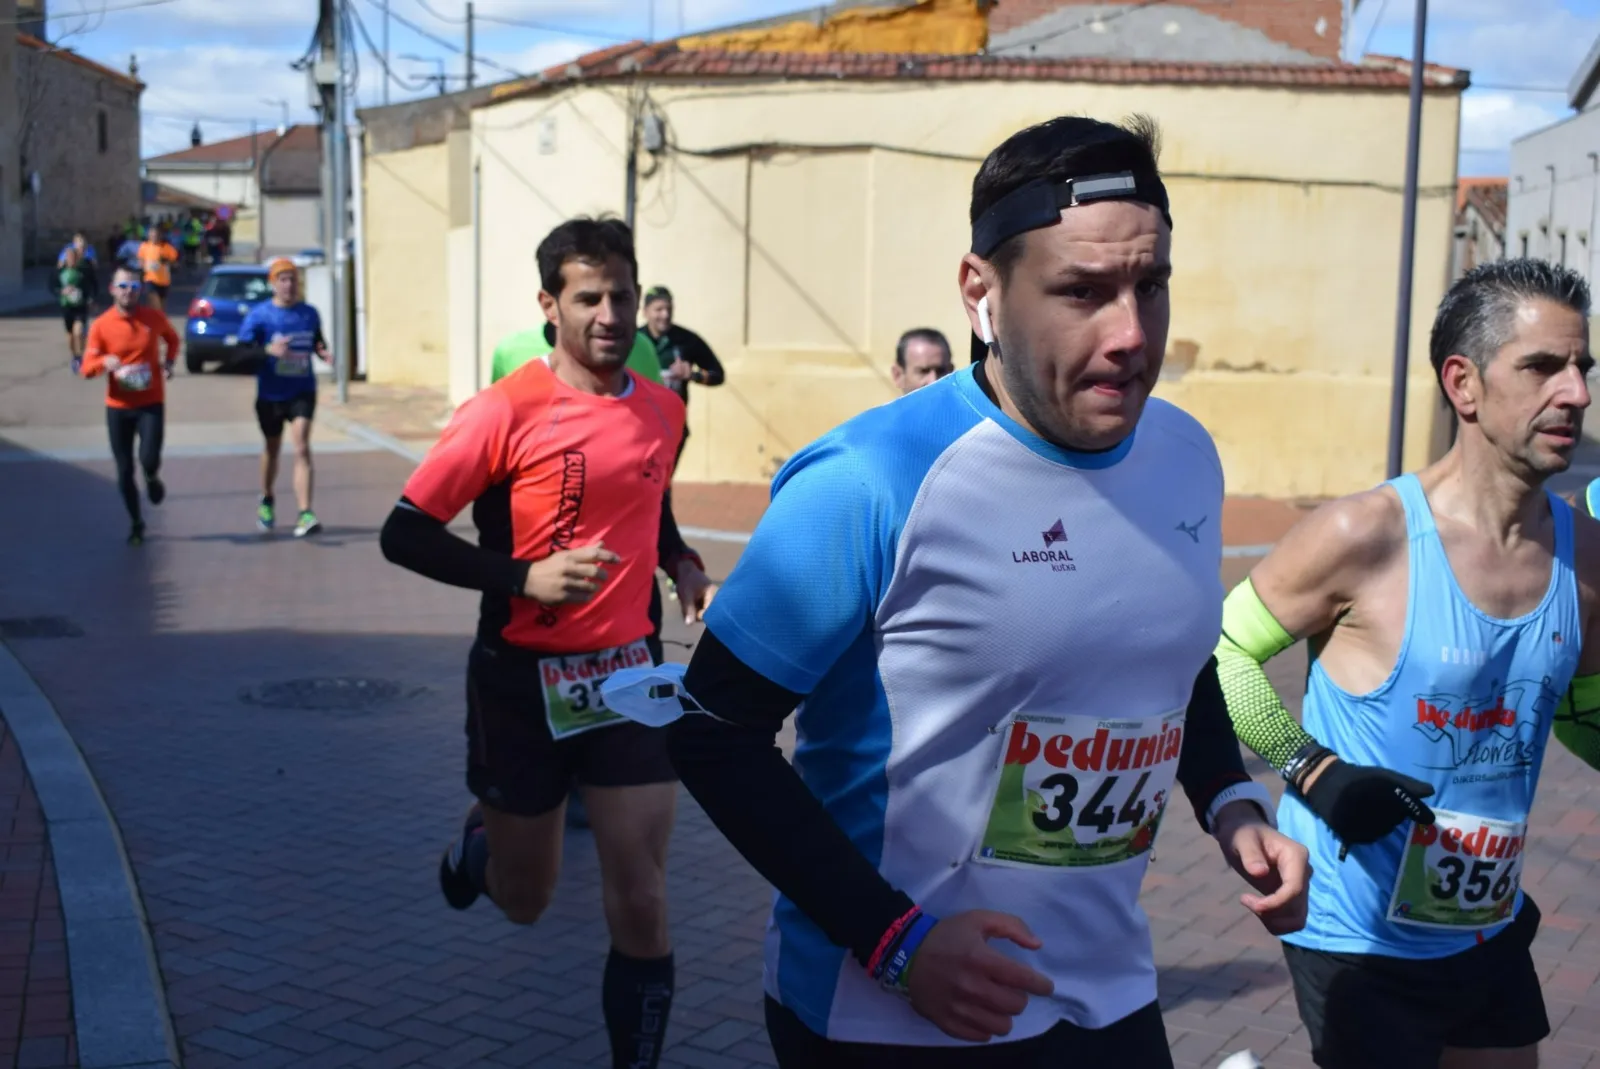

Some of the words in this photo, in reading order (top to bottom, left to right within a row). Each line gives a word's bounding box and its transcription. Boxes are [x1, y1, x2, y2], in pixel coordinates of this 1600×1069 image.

[1012, 549, 1074, 564] LABORAL
[1051, 562, 1077, 572] kutxa
[1004, 720, 1183, 772] bedunia
[1463, 739, 1538, 766] FLOWERS
[1032, 771, 1153, 834] 344
[1394, 786, 1422, 817] KIPSTA
[1430, 855, 1516, 903] 356
[894, 951, 907, 966] UP
